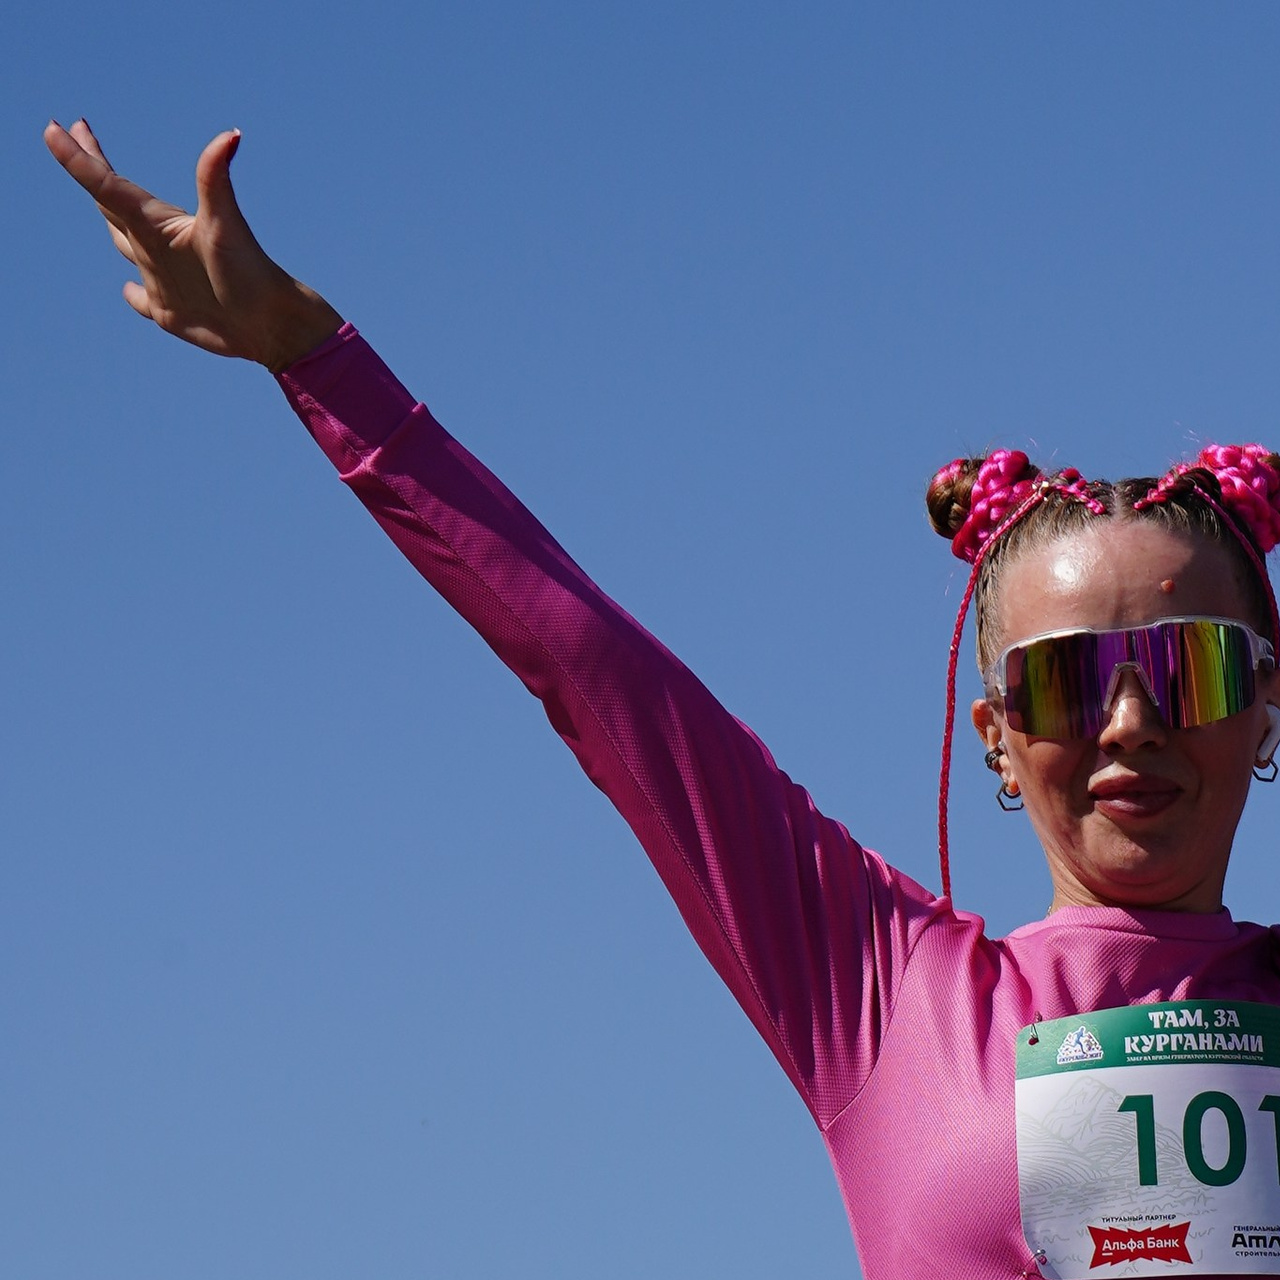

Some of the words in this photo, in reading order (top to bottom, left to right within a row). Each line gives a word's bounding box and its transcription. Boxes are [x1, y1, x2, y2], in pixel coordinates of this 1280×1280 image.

[1148, 1008, 1209, 1030] ТАМ,
[1213, 1008, 1241, 1028] ЗА
[1124, 1032, 1264, 1054] КУРГАНАМИ
[1101, 1214, 1144, 1223] ТИТУЛЬНЫЙ
[1145, 1213, 1177, 1221] ПАРТНЕР
[1233, 1224, 1280, 1232] ГЕНЕРАЛЬНЫЙ
[1102, 1238, 1145, 1253] Альфа
[1147, 1236, 1180, 1249] Банк
